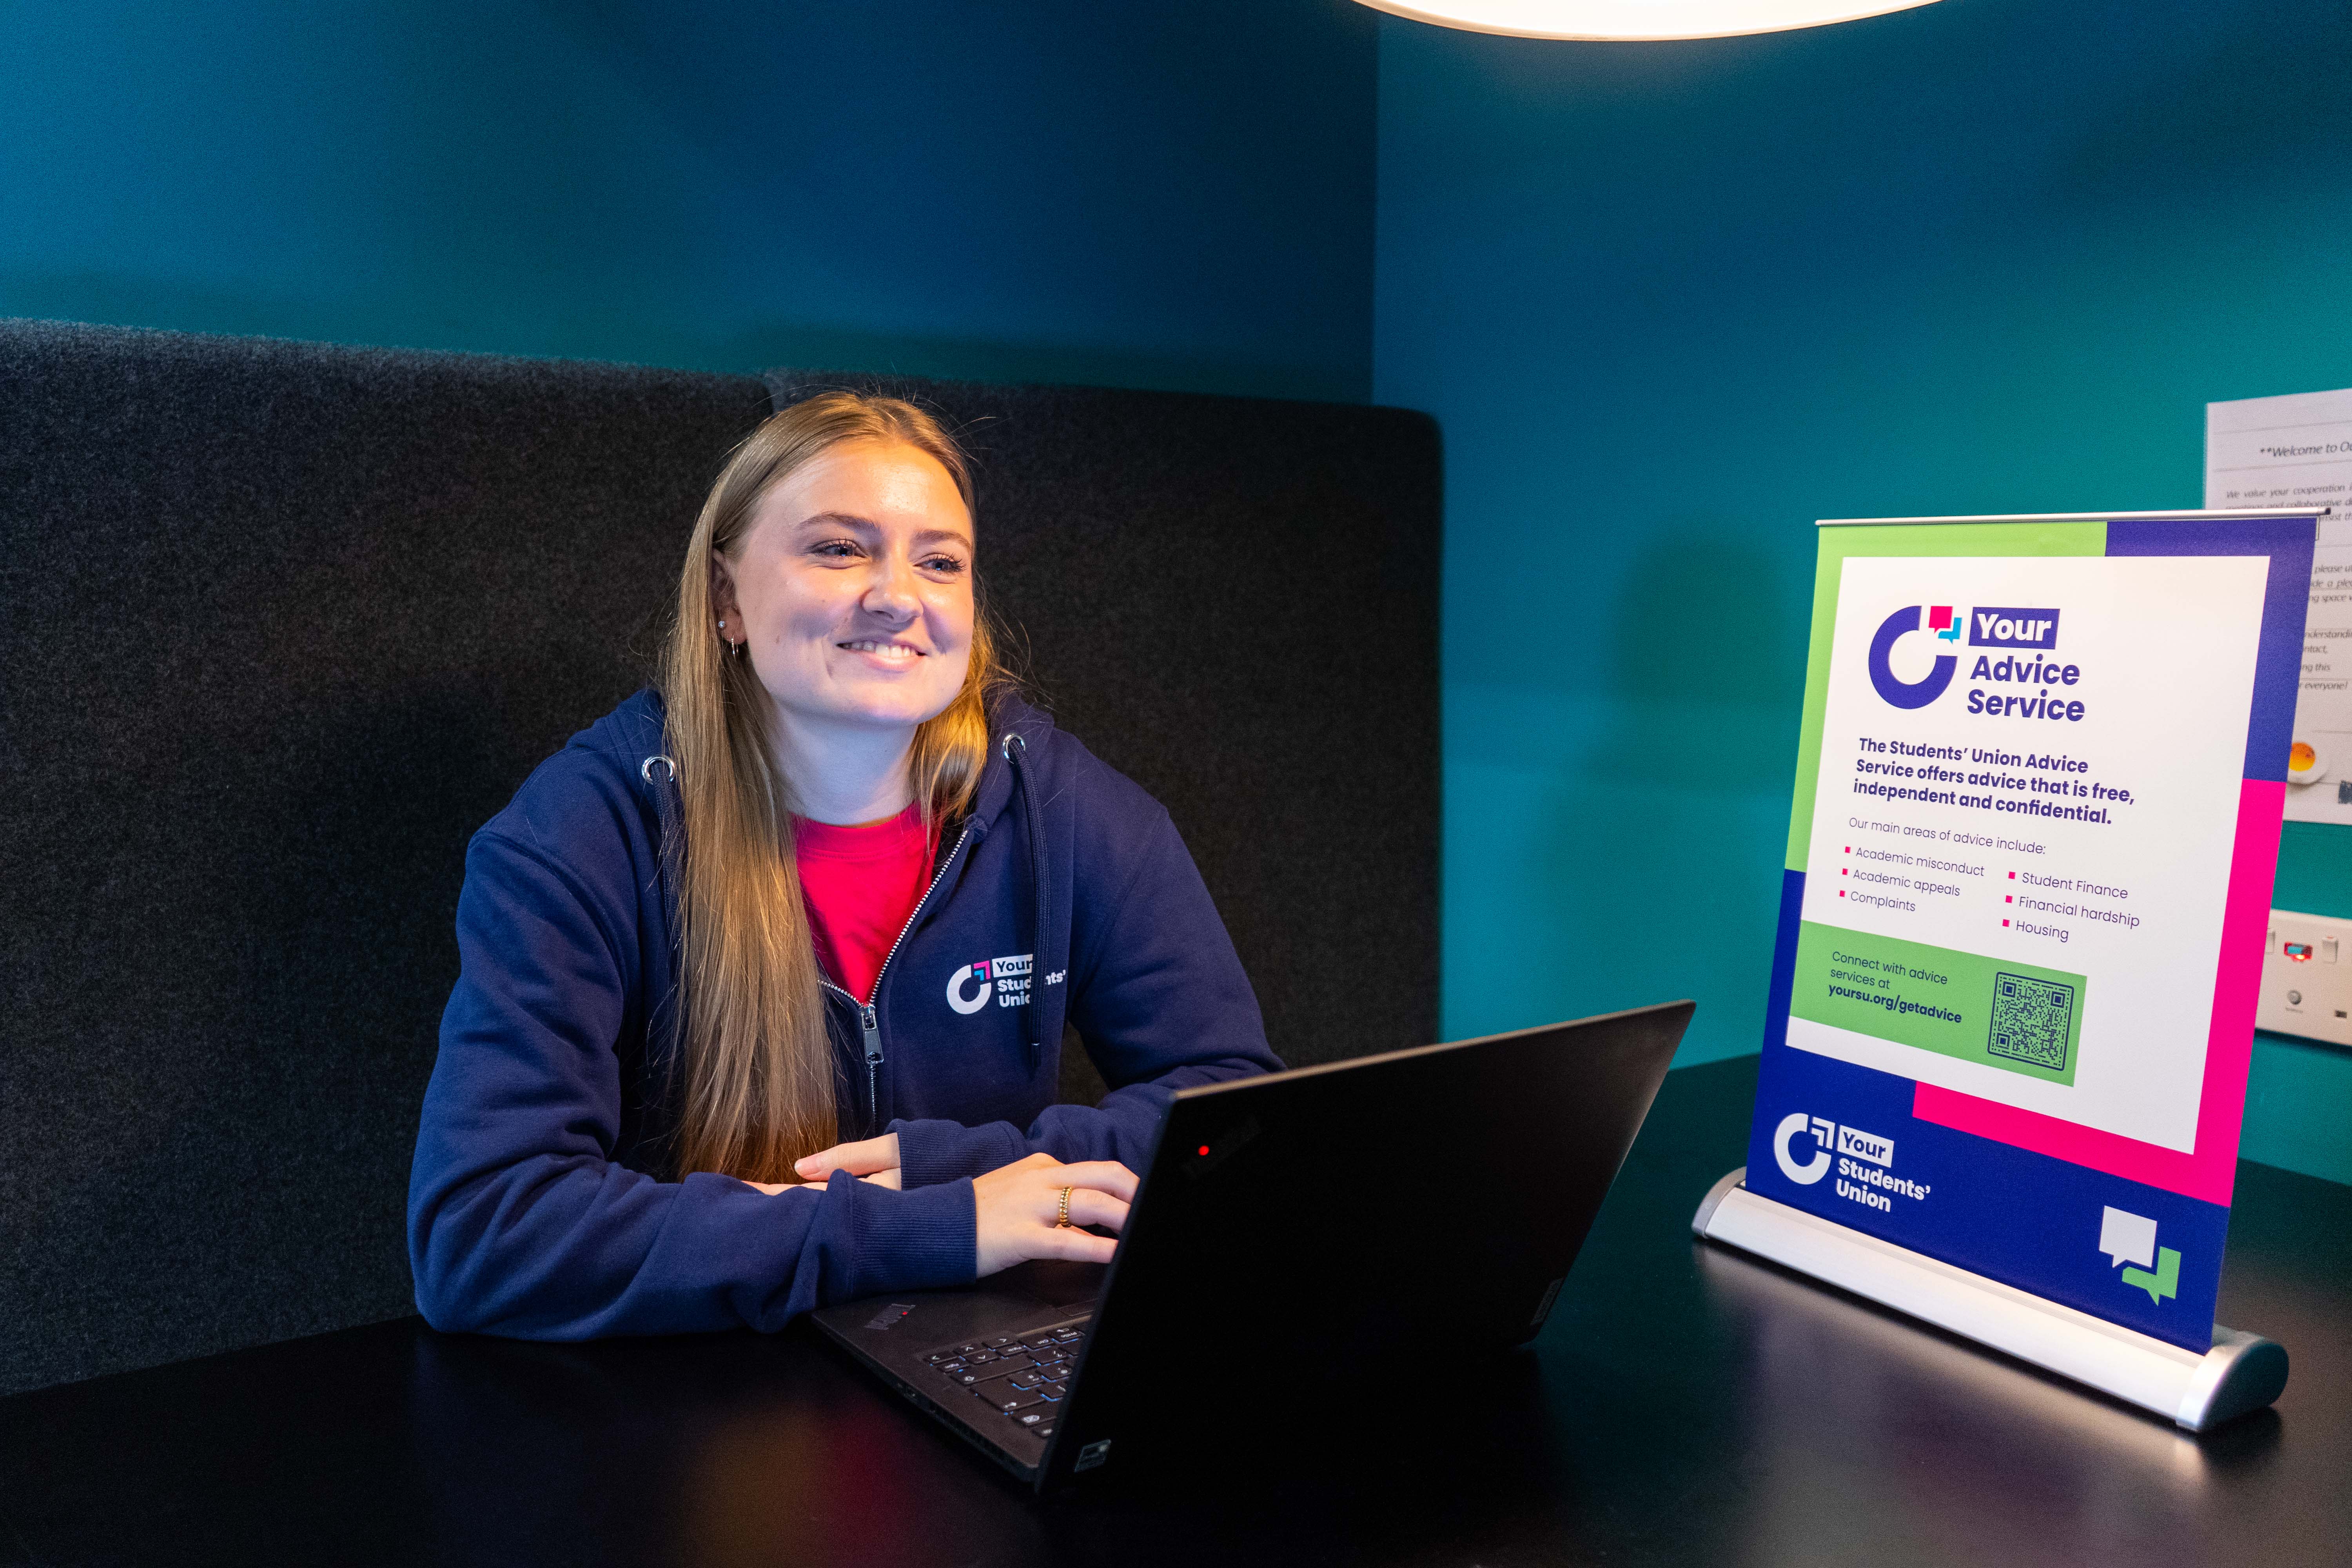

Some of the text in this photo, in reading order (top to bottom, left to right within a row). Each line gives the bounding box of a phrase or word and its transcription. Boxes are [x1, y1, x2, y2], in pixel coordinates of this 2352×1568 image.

[2326, 444, 2337, 453] to
[2270, 489, 2288, 498] your
[2293, 485, 2345, 495] cooperation
[2314, 564, 2343, 574] please
[2322, 595, 2347, 603] space
[1977, 613, 2051, 641] Your
[1970, 653, 2080, 685] Advice
[2304, 681, 2348, 691] everyone!
[1967, 689, 2085, 721] Service
[1860, 738, 1886, 753] The
[1971, 749, 2022, 766] Union
[2025, 754, 2089, 773] Advice
[1856, 759, 2135, 805] Service offers advice that is free,
[1853, 779, 2112, 824] independent and confidential.
[1849, 817, 2046, 855] Our main areas of advice include:
[1856, 847, 1985, 877] Academic misconduct
[1853, 869, 1960, 896] Academic appeals
[2022, 873, 2128, 899] Student Finance
[1851, 891, 1916, 911] Complaints
[2019, 896, 2140, 929] Financial hardship
[2016, 920, 2069, 943] Housing
[996, 959, 1033, 973] Your
[1831, 969, 1891, 989] services at
[1832, 951, 1948, 985] Connect with advice
[1828, 984, 1962, 1024] yoursu.org/getadvice
[1843, 1131, 1886, 1159] Your
[1836, 1178, 1891, 1212] Union
